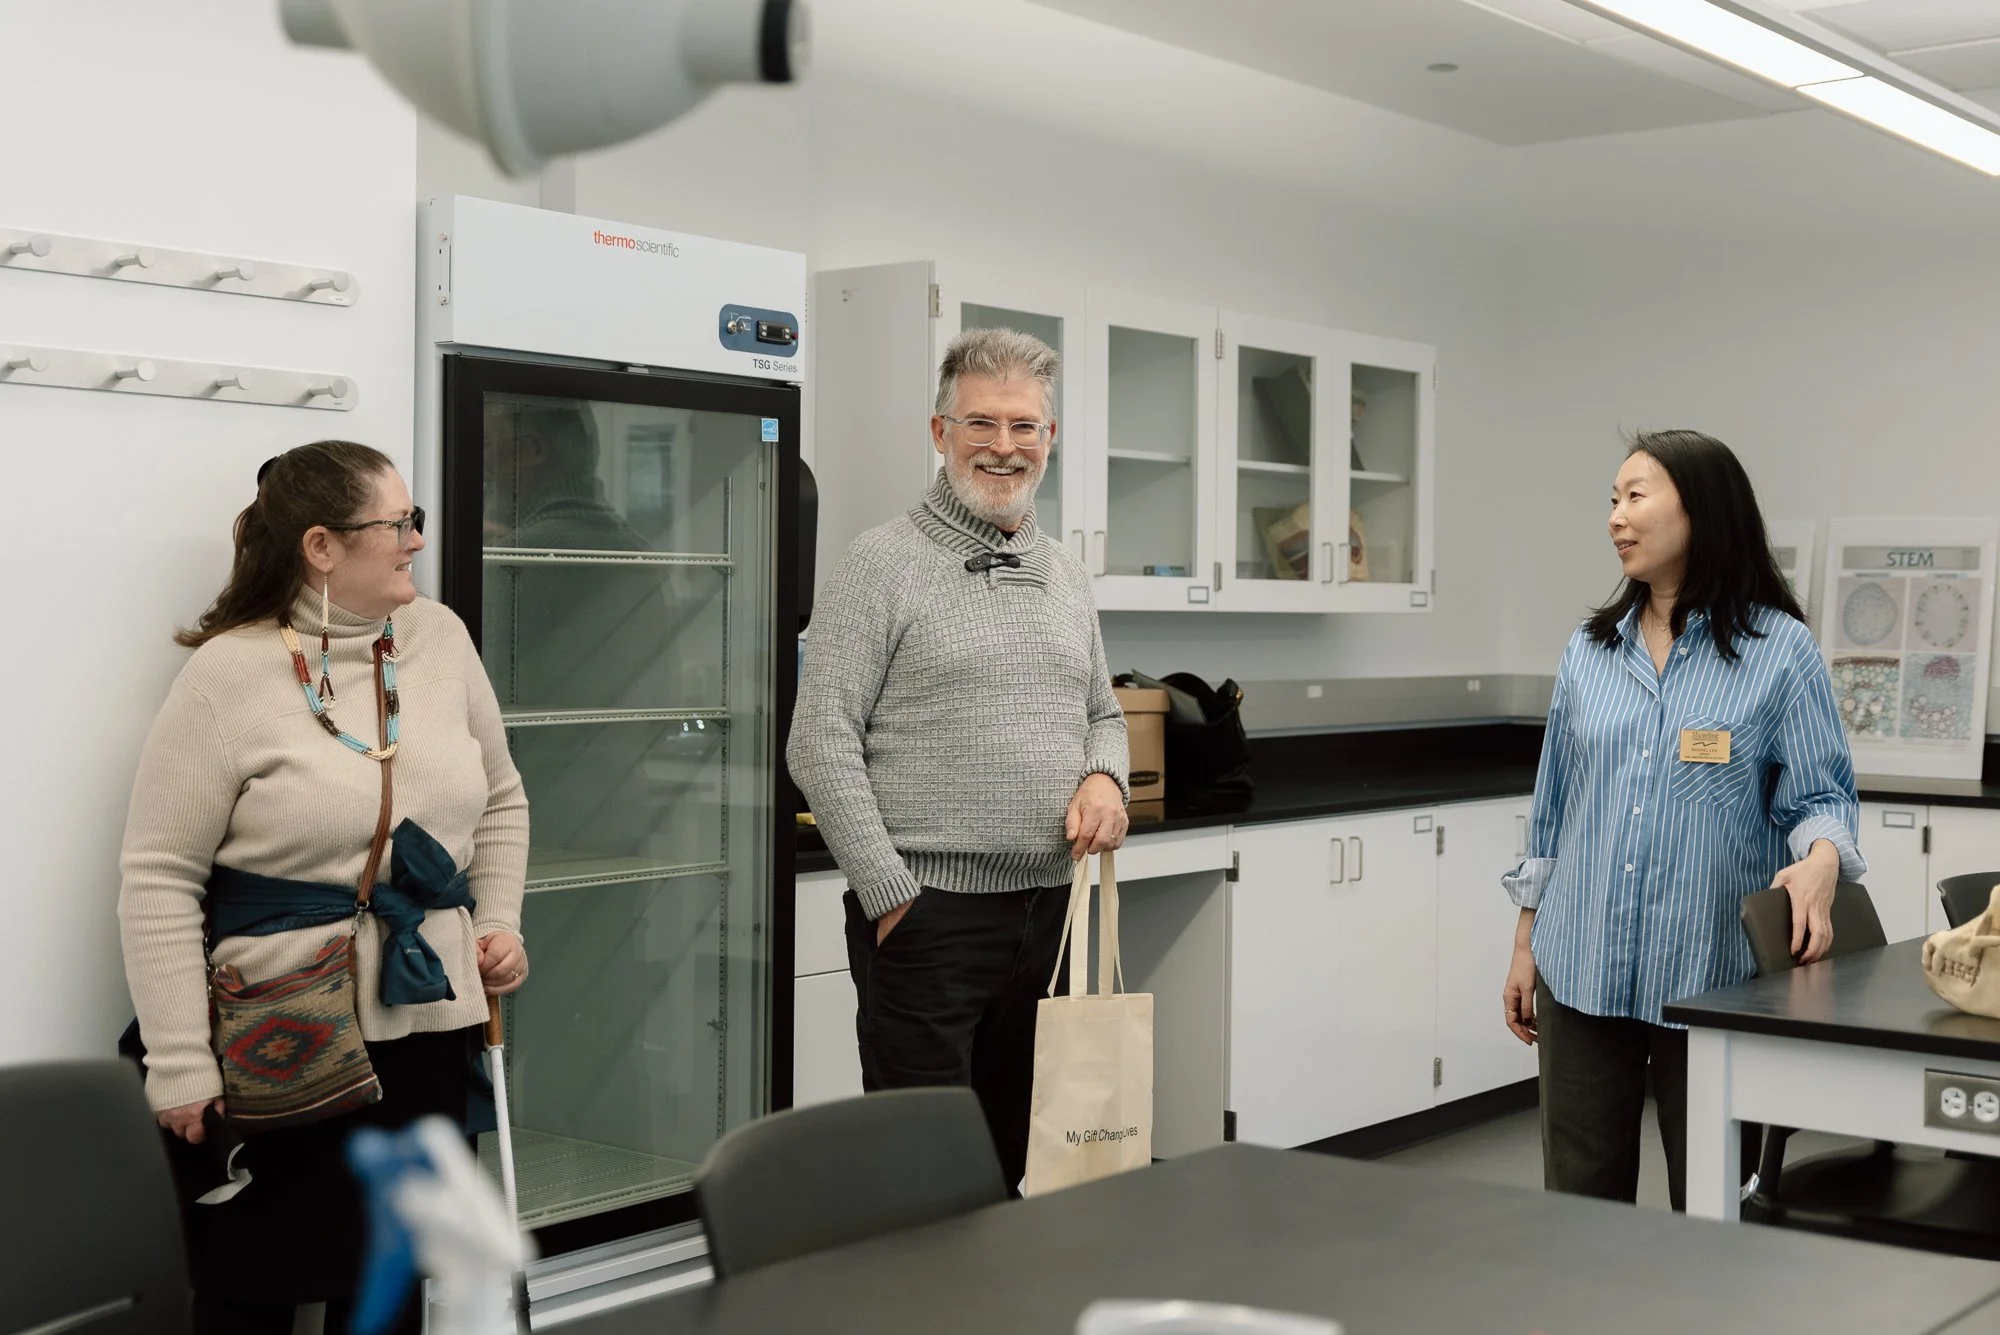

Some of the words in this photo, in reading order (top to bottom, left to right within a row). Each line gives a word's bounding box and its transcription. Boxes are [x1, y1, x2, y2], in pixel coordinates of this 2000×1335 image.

[593, 229, 636, 250] thermo
[636, 239, 680, 258] scientific
[753, 358, 771, 370] TSG
[772, 360, 798, 374] Series
[1885, 551, 1935, 568] STEM
[1691, 731, 1720, 740] Shoreline
[1066, 1130, 1081, 1146] My
[1083, 1129, 1098, 1143] Gift
